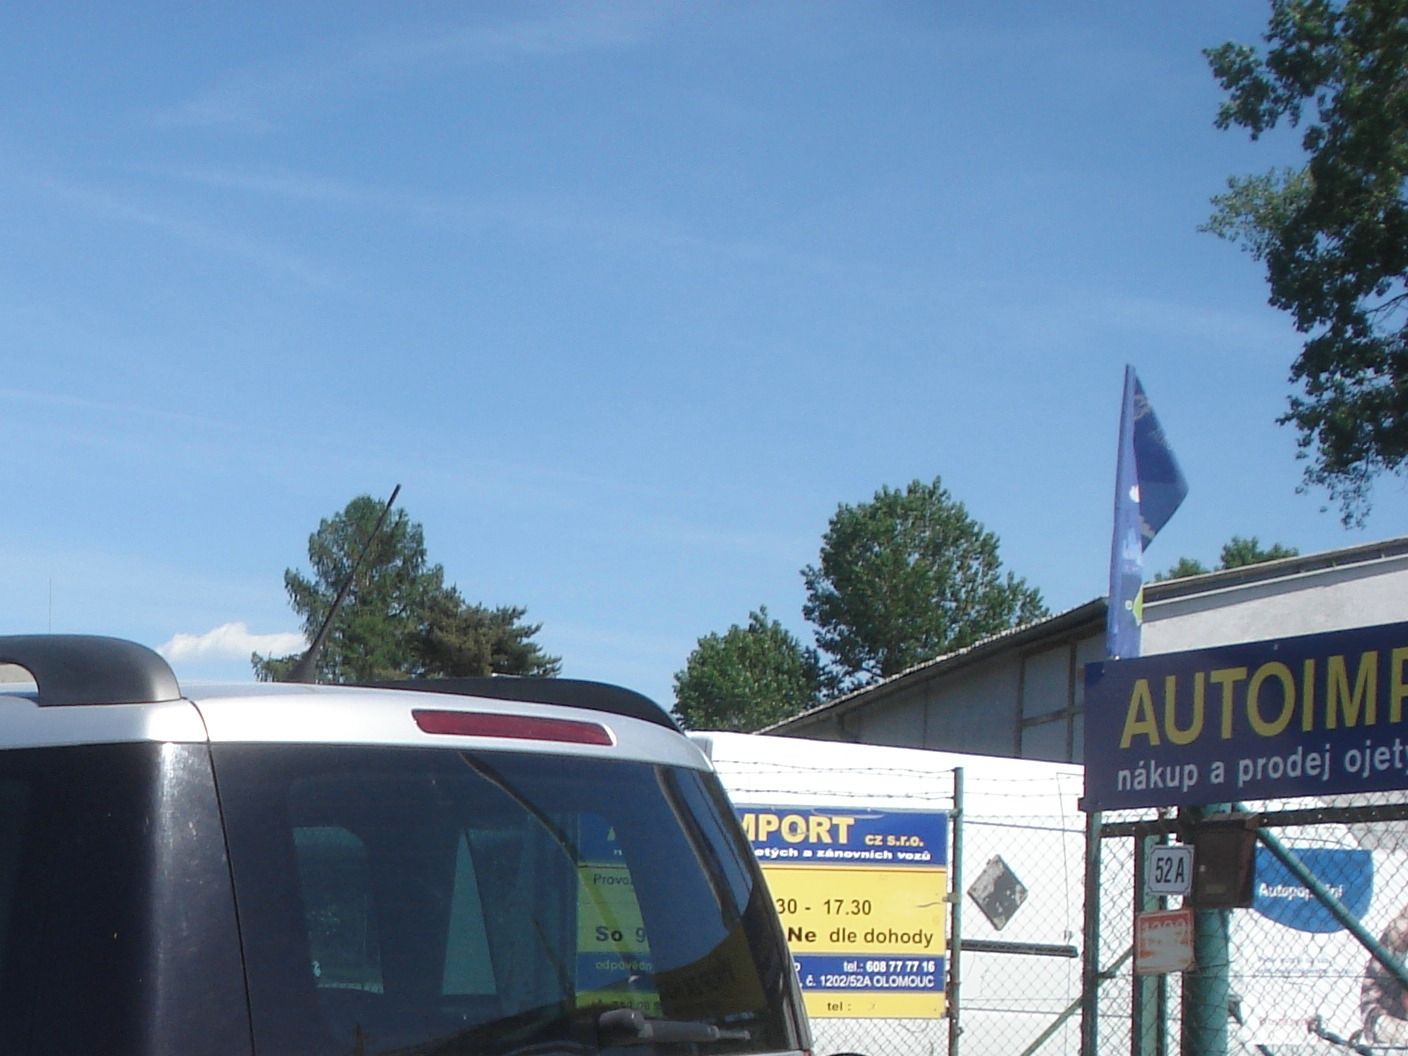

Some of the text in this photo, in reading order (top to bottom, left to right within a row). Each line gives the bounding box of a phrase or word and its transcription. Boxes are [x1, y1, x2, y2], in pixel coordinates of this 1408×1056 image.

[1117, 737, 1408, 792] nákup a prodej ojet
[887, 834, 924, 847] s.r.o.
[817, 848, 893, 860] zánovních
[897, 850, 931, 861] vozů
[823, 900, 872, 915] 17.30
[595, 926, 623, 942] So
[787, 926, 933, 948] Ne dle dohody
[866, 961, 887, 972] 608
[889, 961, 902, 972] 77
[905, 961, 919, 972] 77
[820, 975, 871, 987] 1202/52A
[873, 976, 935, 987] OLOMOUC
